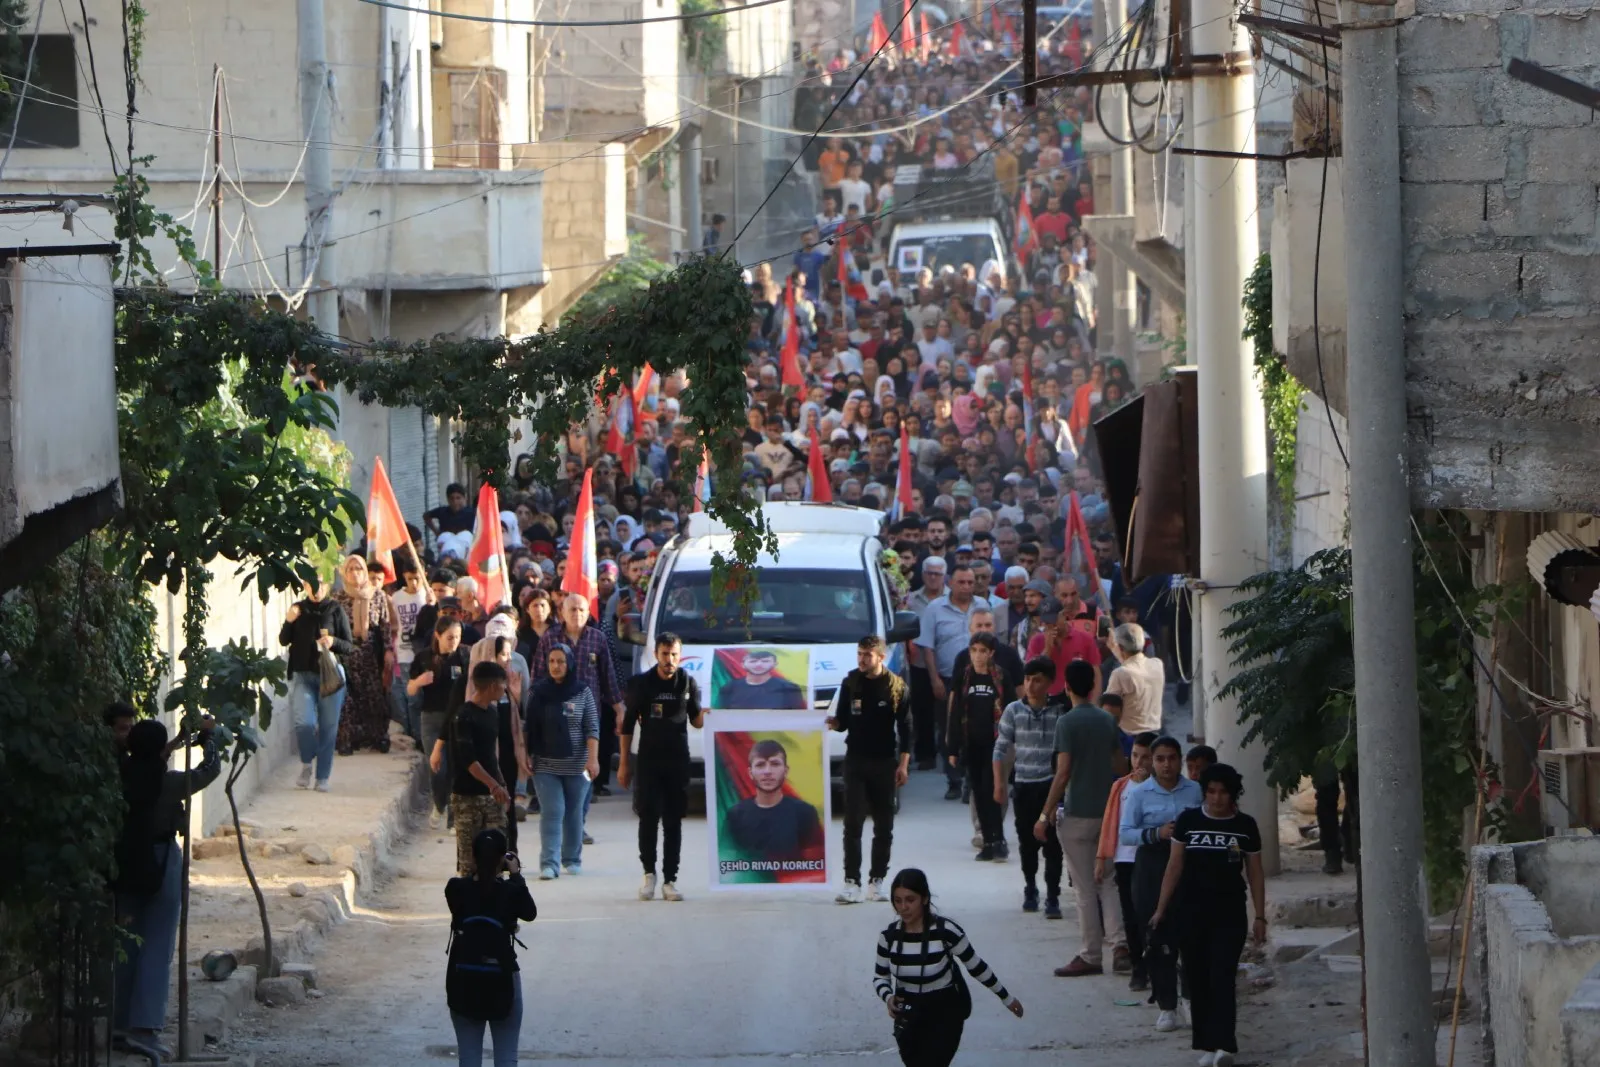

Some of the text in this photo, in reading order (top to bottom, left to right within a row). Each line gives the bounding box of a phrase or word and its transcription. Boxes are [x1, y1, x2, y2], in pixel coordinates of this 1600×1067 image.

[398, 603, 418, 615] OLD
[1190, 834, 1238, 846] ZARA
[752, 861, 780, 871] RIYAD
